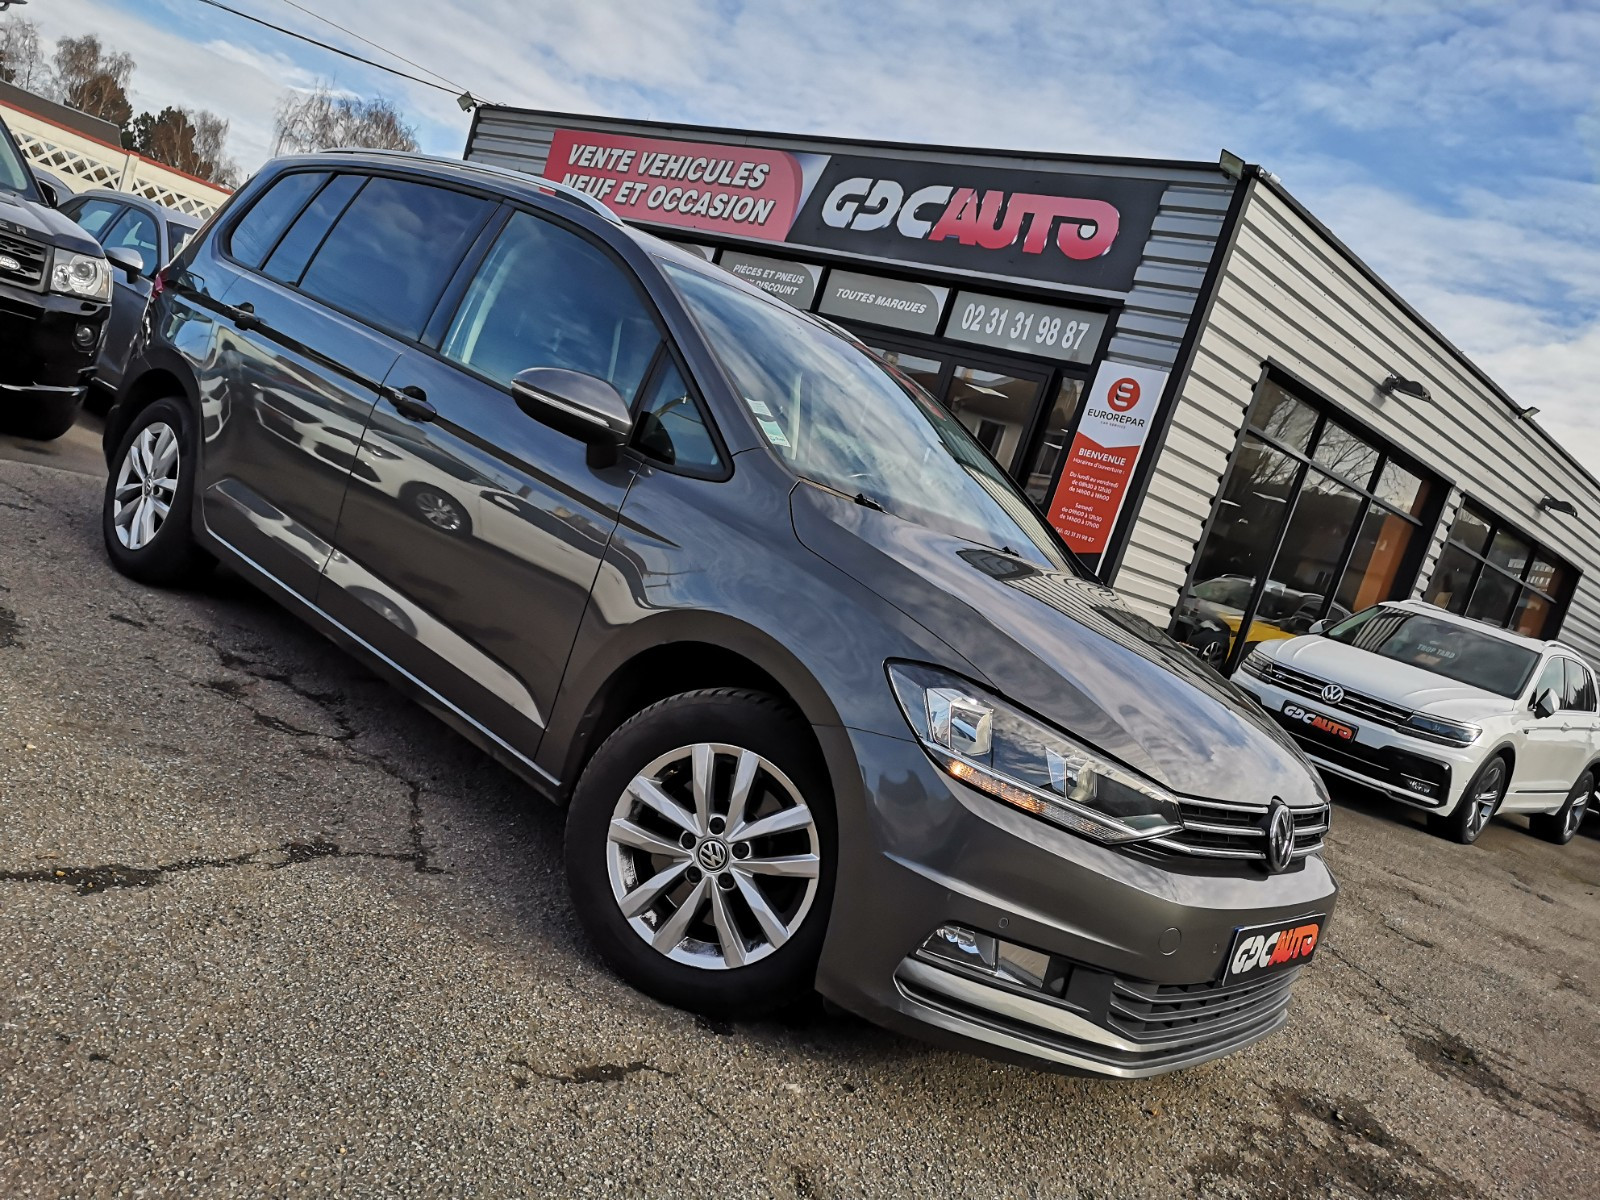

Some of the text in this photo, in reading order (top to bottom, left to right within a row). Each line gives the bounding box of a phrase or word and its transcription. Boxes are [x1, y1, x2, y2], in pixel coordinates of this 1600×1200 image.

[567, 143, 771, 189] VENTE VEHICULES
[562, 172, 776, 224] NEUF ET OCCASION
[762, 269, 776, 279] ET
[774, 272, 805, 285] PNEUS
[836, 288, 927, 314] TOUTES MARQUES
[961, 303, 1090, 350] 02 31 31 98 87
[1087, 408, 1145, 428] EUROREPAR
[1072, 457, 1094, 467] Horaires
[1078, 447, 1127, 466] BIENVENUE
[1077, 473, 1090, 481] lundi
[1096, 479, 1119, 489] vendredi
[1075, 502, 1094, 512] Samedi
